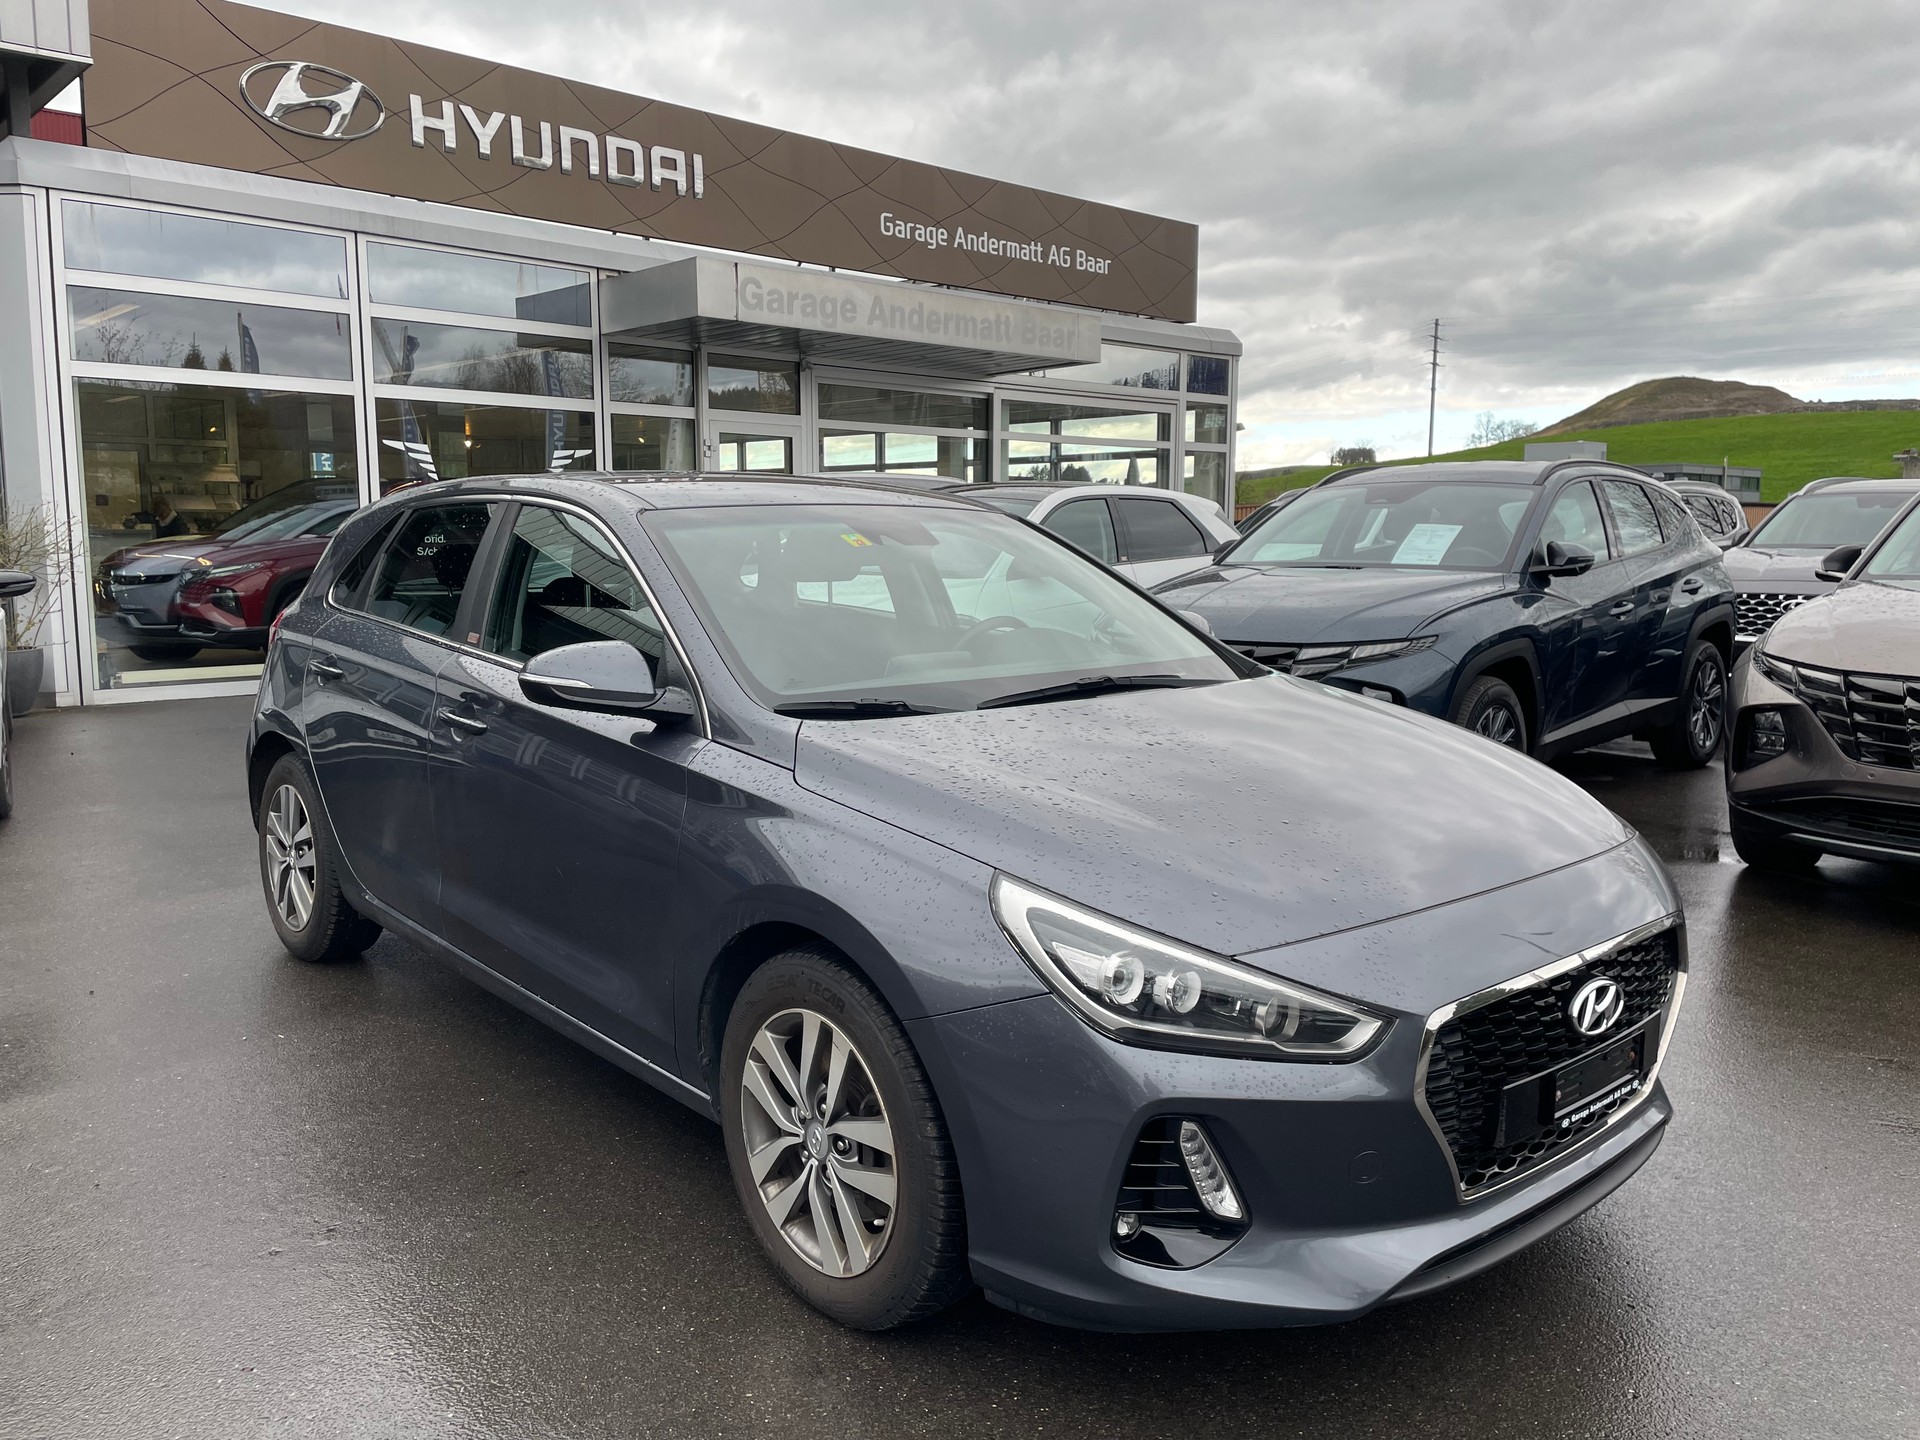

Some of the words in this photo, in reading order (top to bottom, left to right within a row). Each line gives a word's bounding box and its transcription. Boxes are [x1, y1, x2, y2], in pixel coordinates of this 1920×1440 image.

[409, 93, 704, 200] HYUNDAI
[880, 212, 948, 250] Garage
[953, 226, 1043, 264] Andermatt
[1048, 244, 1071, 268] AG
[1076, 249, 1112, 275] Baar
[739, 277, 858, 329] Garage
[867, 295, 1012, 344] Andermatt
[1021, 315, 1077, 350] Baar
